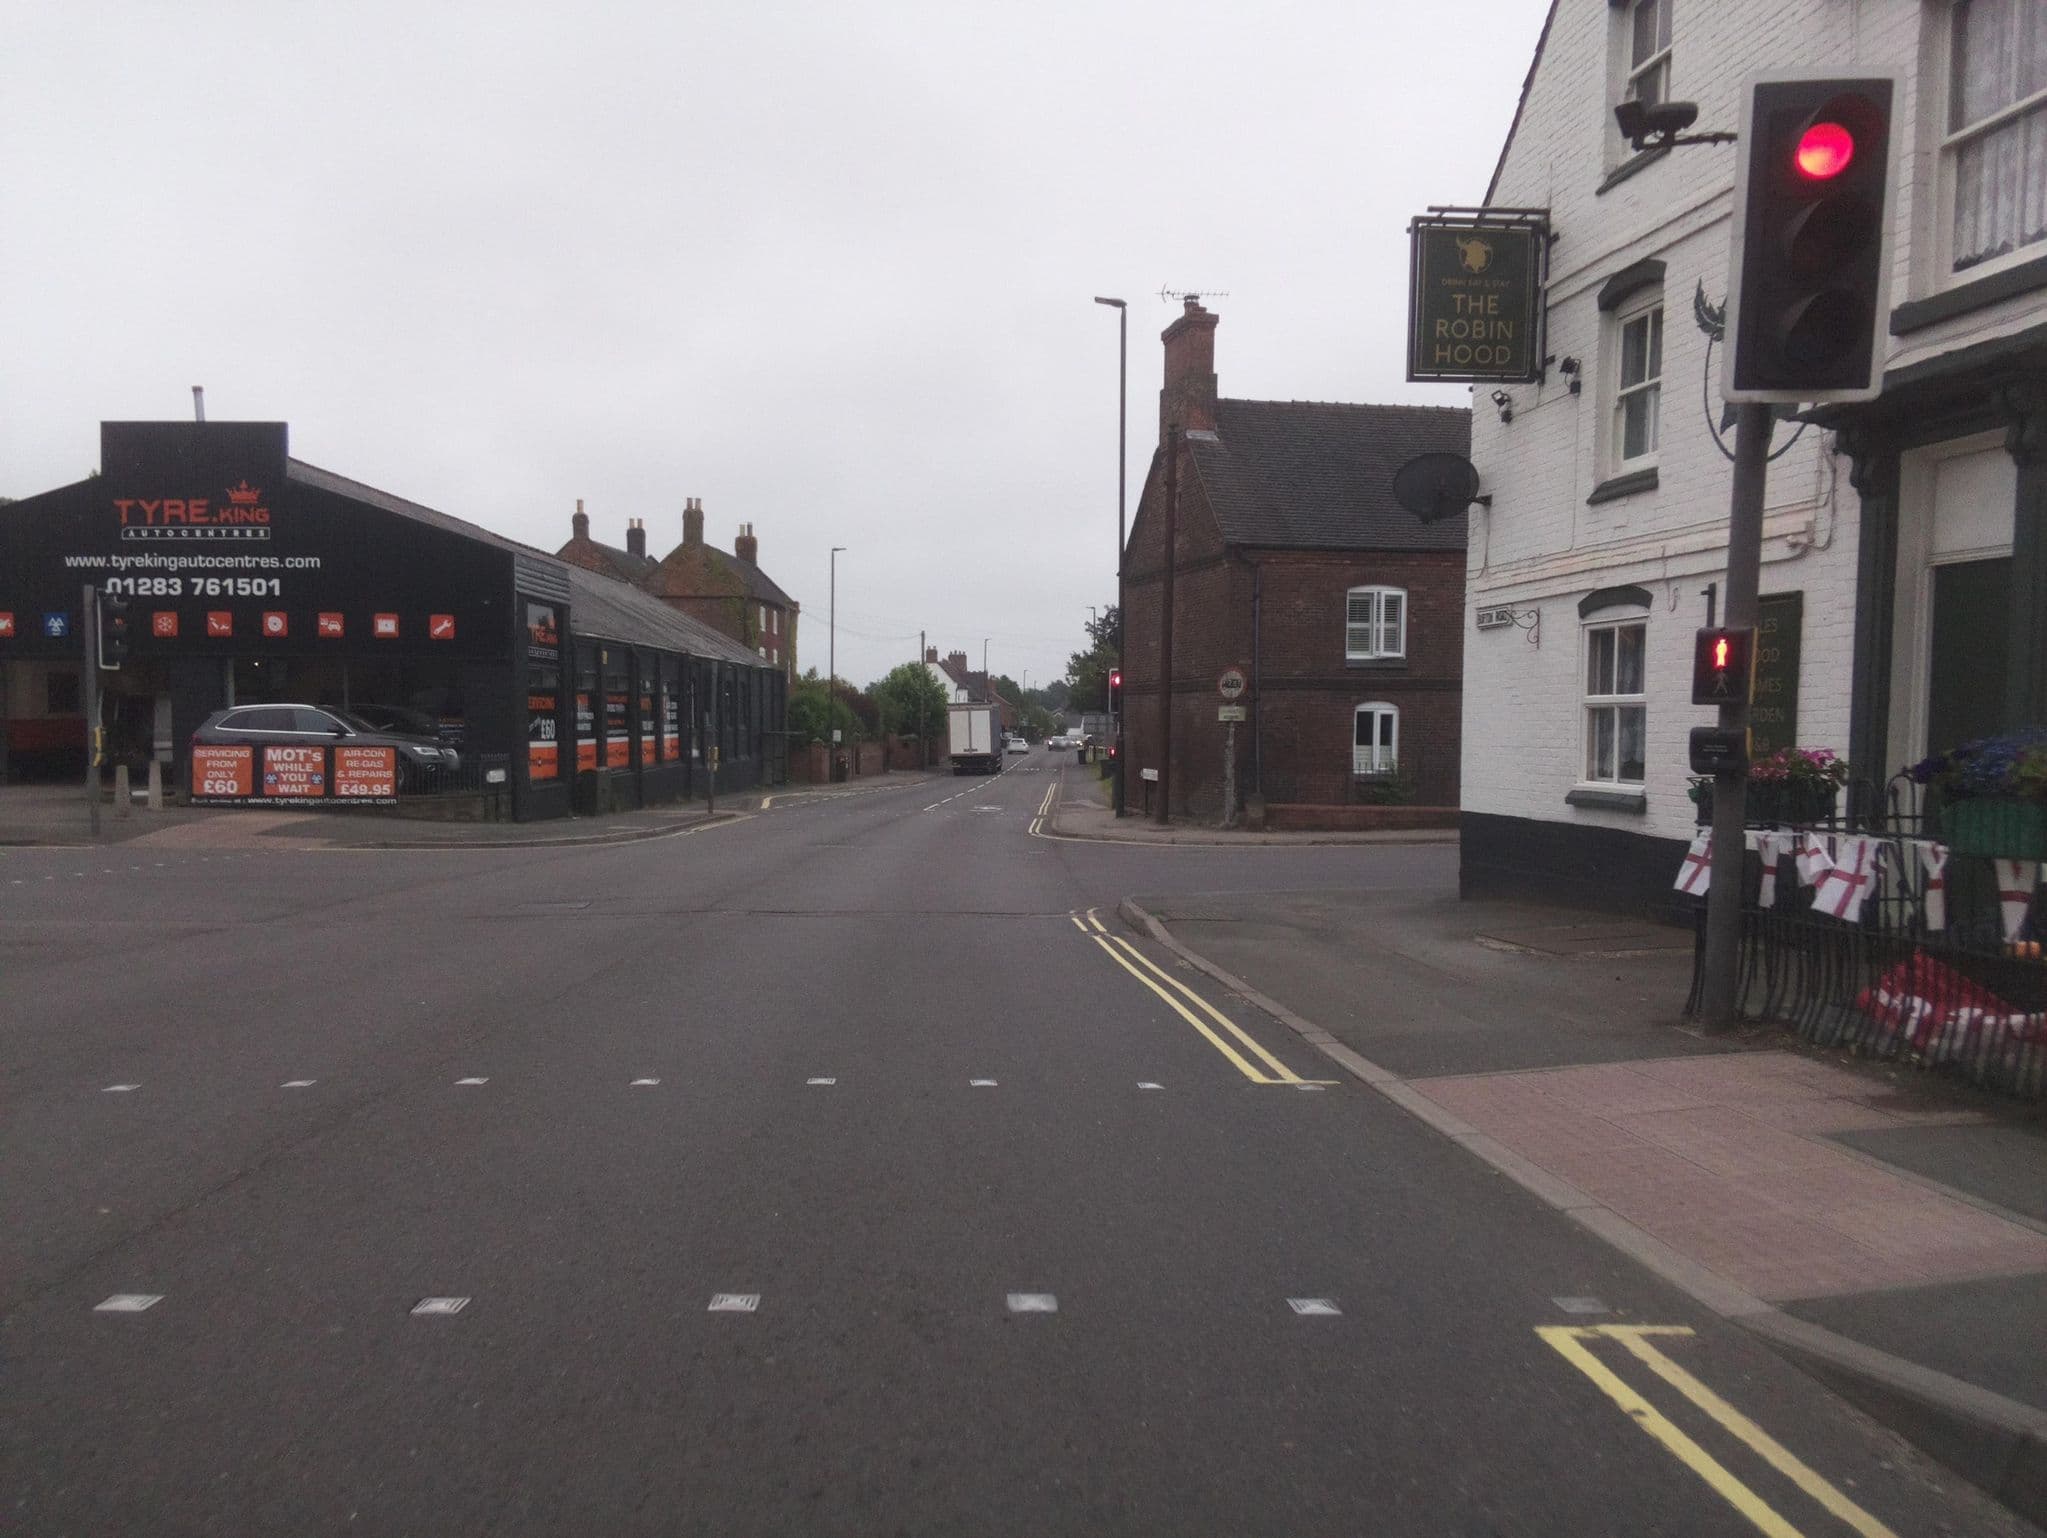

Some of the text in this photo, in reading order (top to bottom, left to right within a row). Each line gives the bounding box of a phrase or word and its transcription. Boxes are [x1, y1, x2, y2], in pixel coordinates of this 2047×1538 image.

[1452, 294, 1500, 315] THE
[1436, 319, 1513, 340] ROBIN
[1434, 344, 1512, 365] HOOD
[128, 529, 266, 537] AUTOCENTRES
[64, 552, 321, 571] www.tyrekingautocentres.com
[105, 577, 281, 596] 01283 761501
[540, 718, 556, 740] £60
[194, 749, 250, 758] SERVICING
[267, 749, 322, 762] MOT's
[343, 750, 386, 758] AIR-CON
[206, 760, 237, 768] FROM
[273, 763, 314, 772] WHILE
[345, 760, 384, 768] RE-GAS
[280, 773, 307, 782] YOU
[348, 770, 393, 779] REPAIRS
[203, 780, 238, 794] £60
[278, 784, 311, 793] WAIT
[340, 784, 391, 796] £49.95
